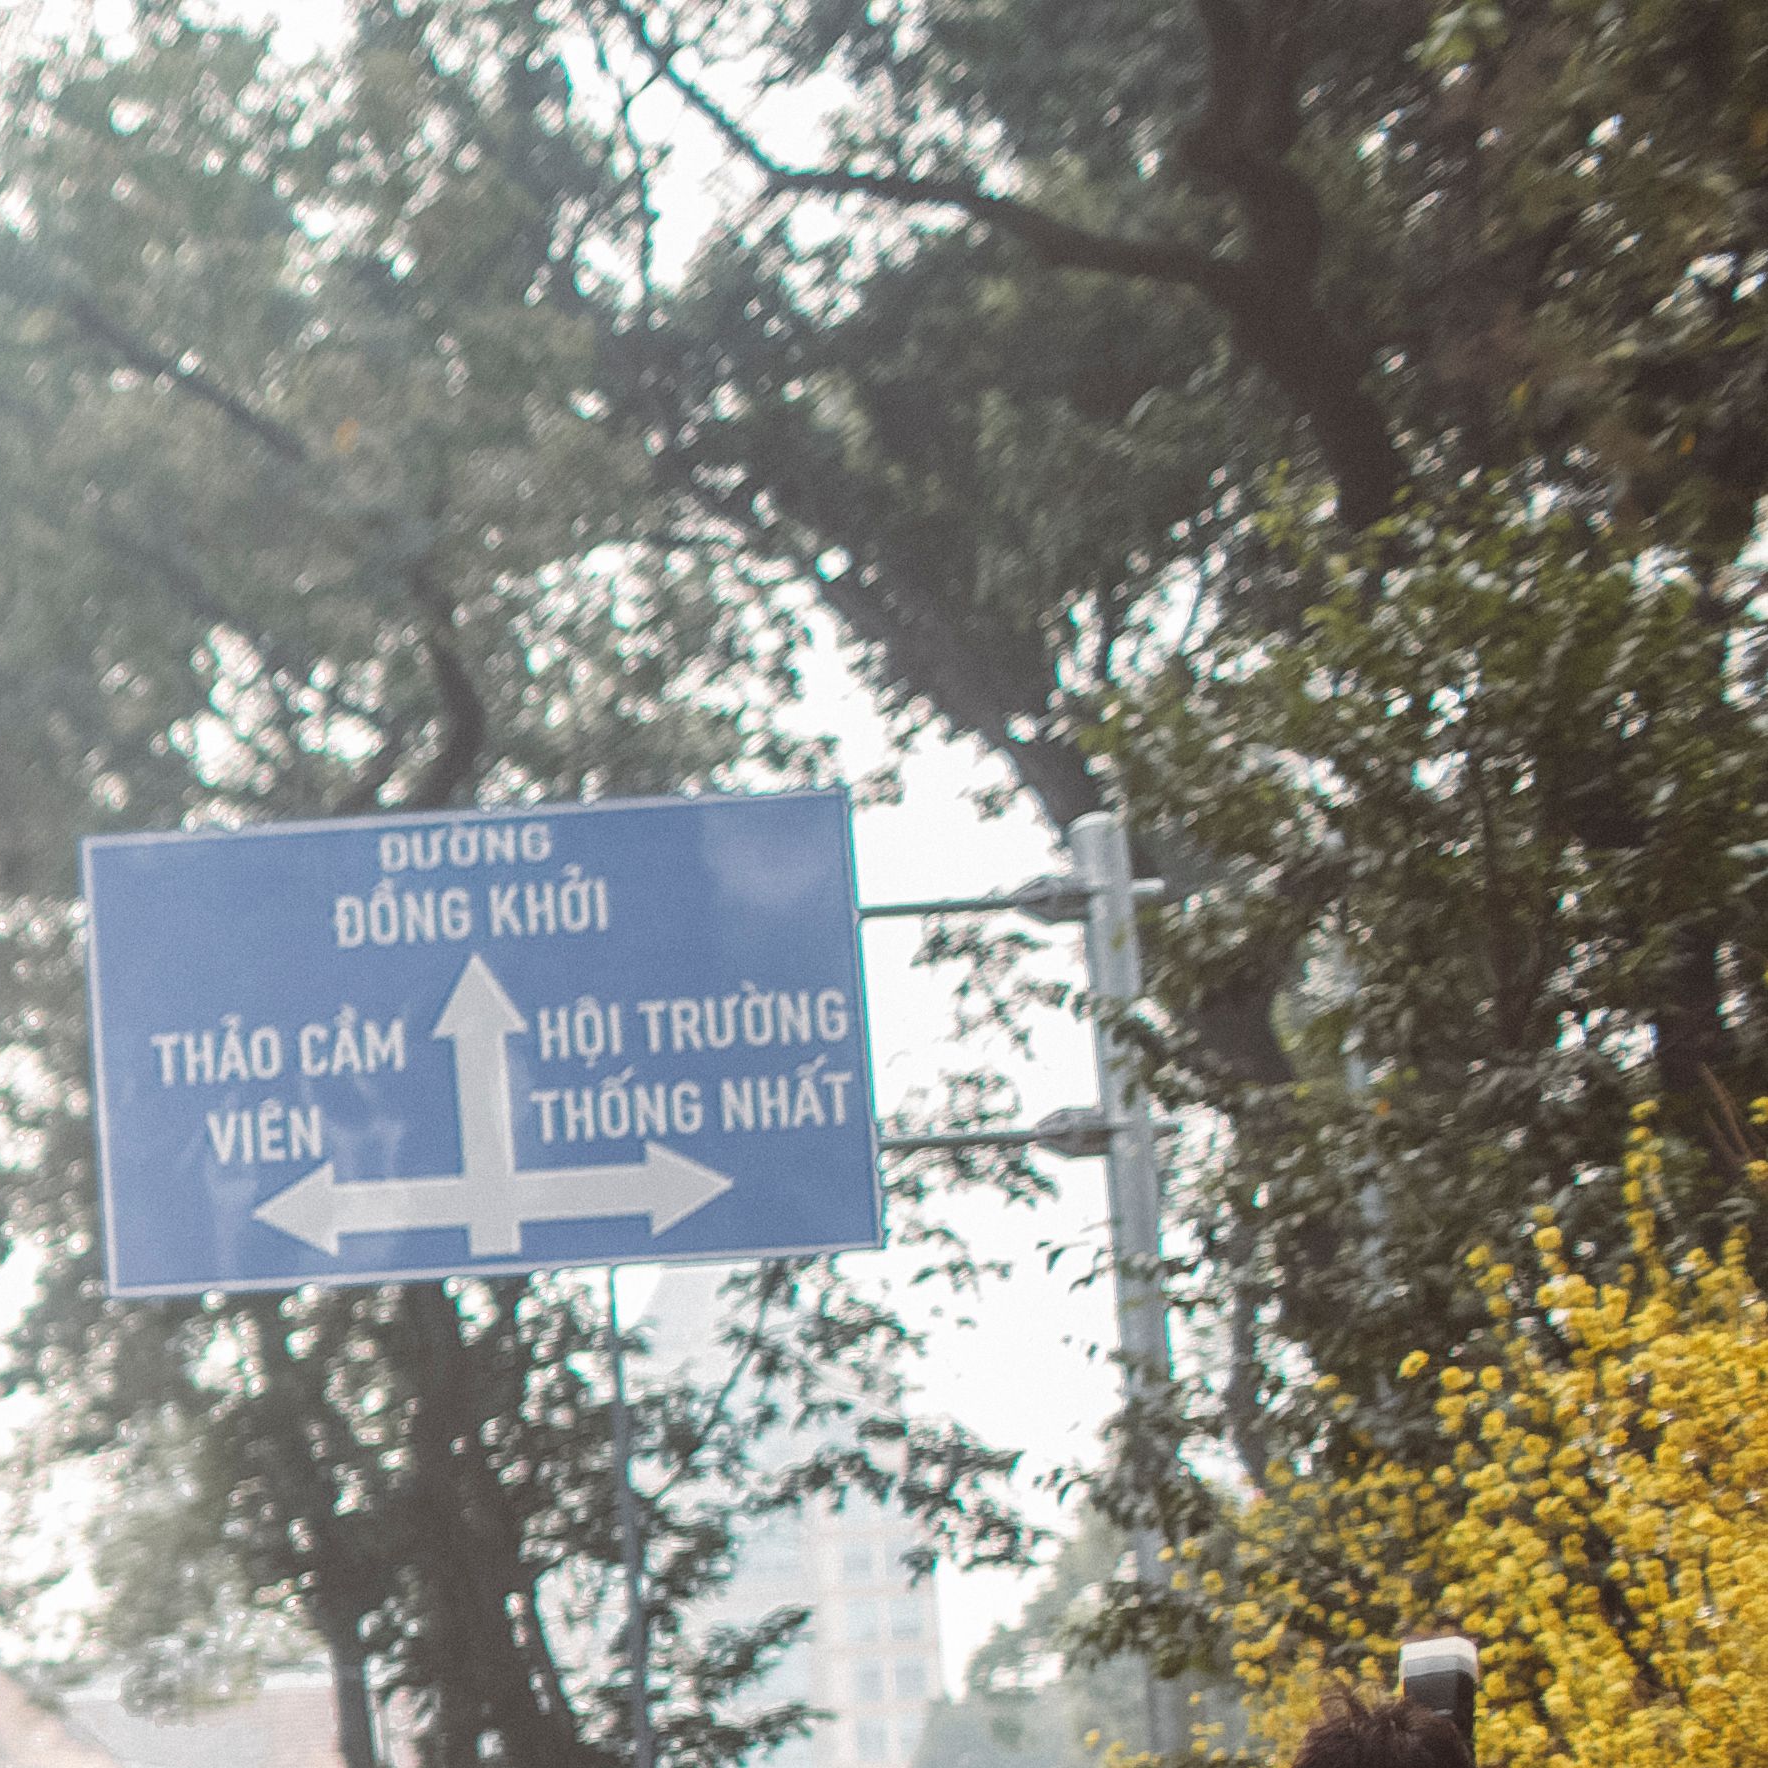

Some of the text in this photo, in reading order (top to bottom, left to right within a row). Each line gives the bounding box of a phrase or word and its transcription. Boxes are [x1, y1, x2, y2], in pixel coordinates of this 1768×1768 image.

[488, 863, 609, 936] KHỞI
[149, 1011, 282, 1087] THẢO
[538, 980, 849, 1068] HỘI TRƯỜNG
[205, 1098, 323, 1166] VIÊN
[529, 1054, 852, 1143] THỐNG NHẤT
